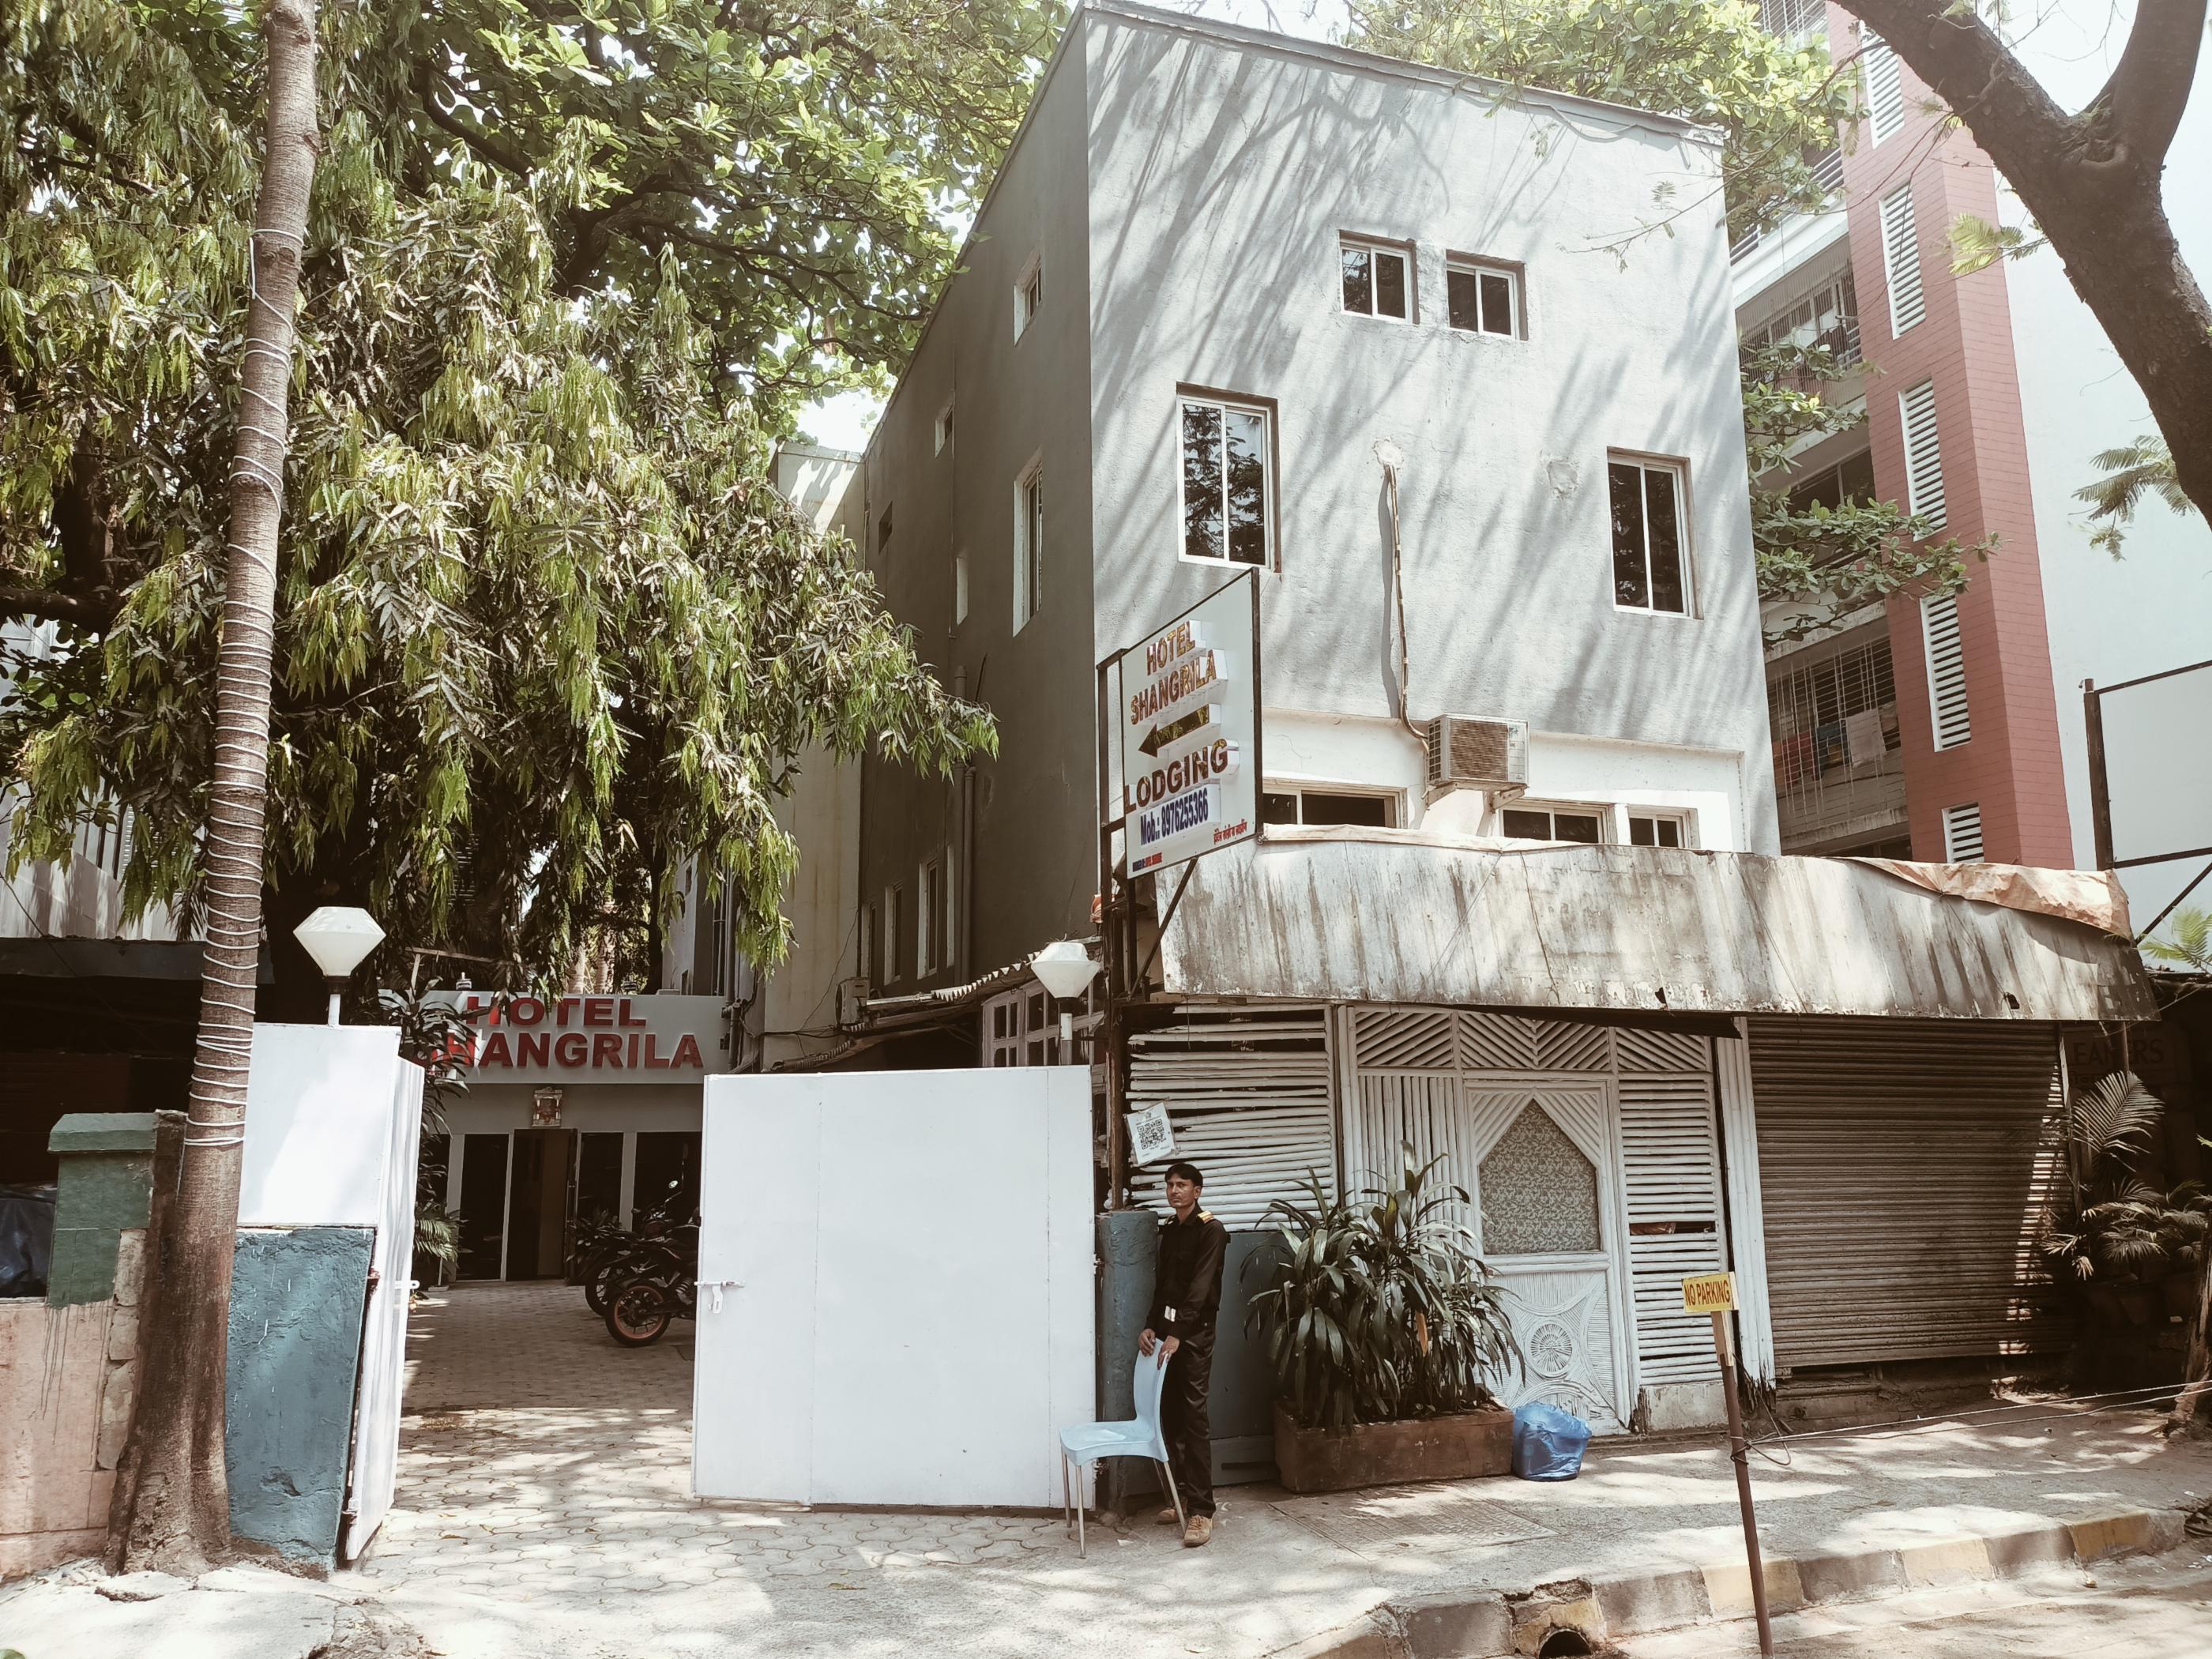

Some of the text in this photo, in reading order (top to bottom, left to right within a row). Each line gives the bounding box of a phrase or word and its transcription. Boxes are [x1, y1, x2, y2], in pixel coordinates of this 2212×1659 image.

[1147, 621, 1195, 676] HOTEL
[1130, 649, 1217, 725] SHANGRILA
[1124, 738, 1228, 814] LODGING
[1161, 788, 1209, 837] 8976255366
[465, 995, 647, 1027] HOTEL
[1683, 1280, 1731, 1306] NO PARKING
